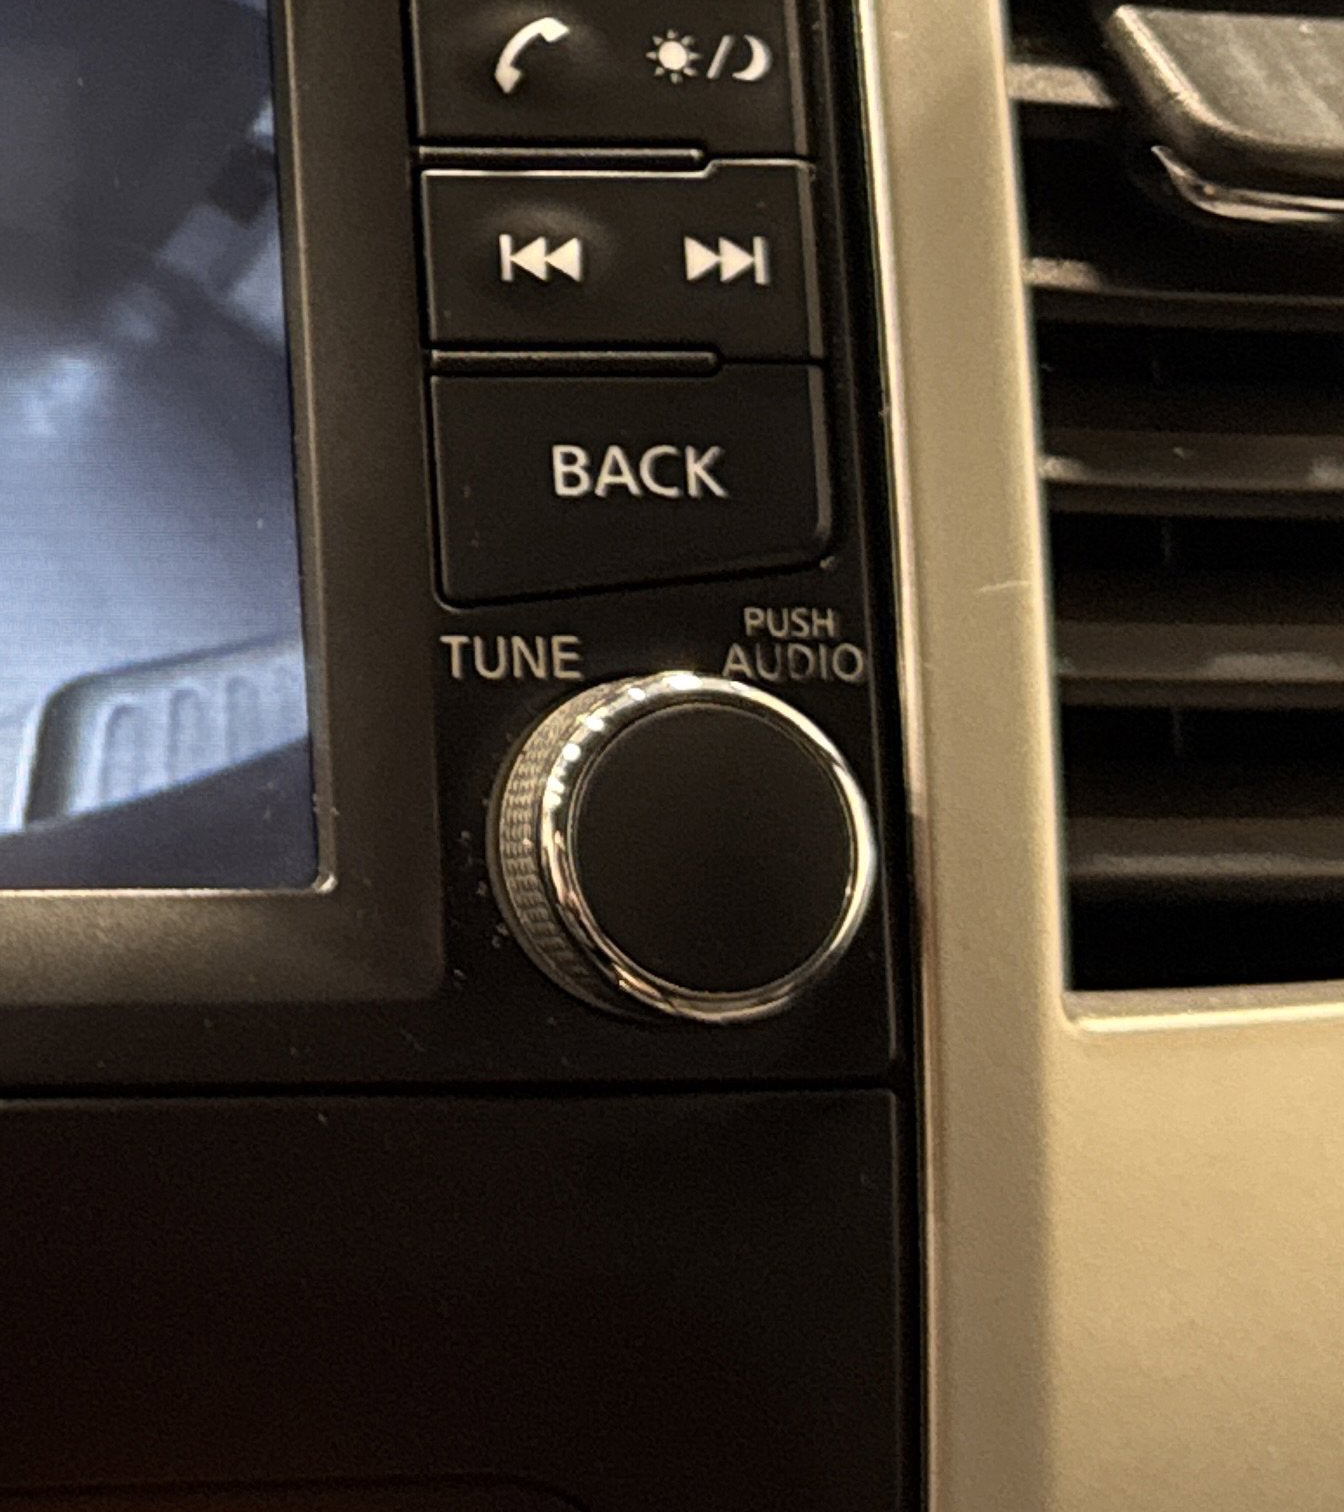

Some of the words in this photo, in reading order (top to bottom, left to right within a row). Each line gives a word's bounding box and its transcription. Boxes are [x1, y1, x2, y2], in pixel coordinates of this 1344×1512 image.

[551, 443, 730, 499] BACK
[743, 607, 838, 639] PUSH
[440, 634, 585, 681] TUNE
[722, 641, 865, 683] AUDIO
